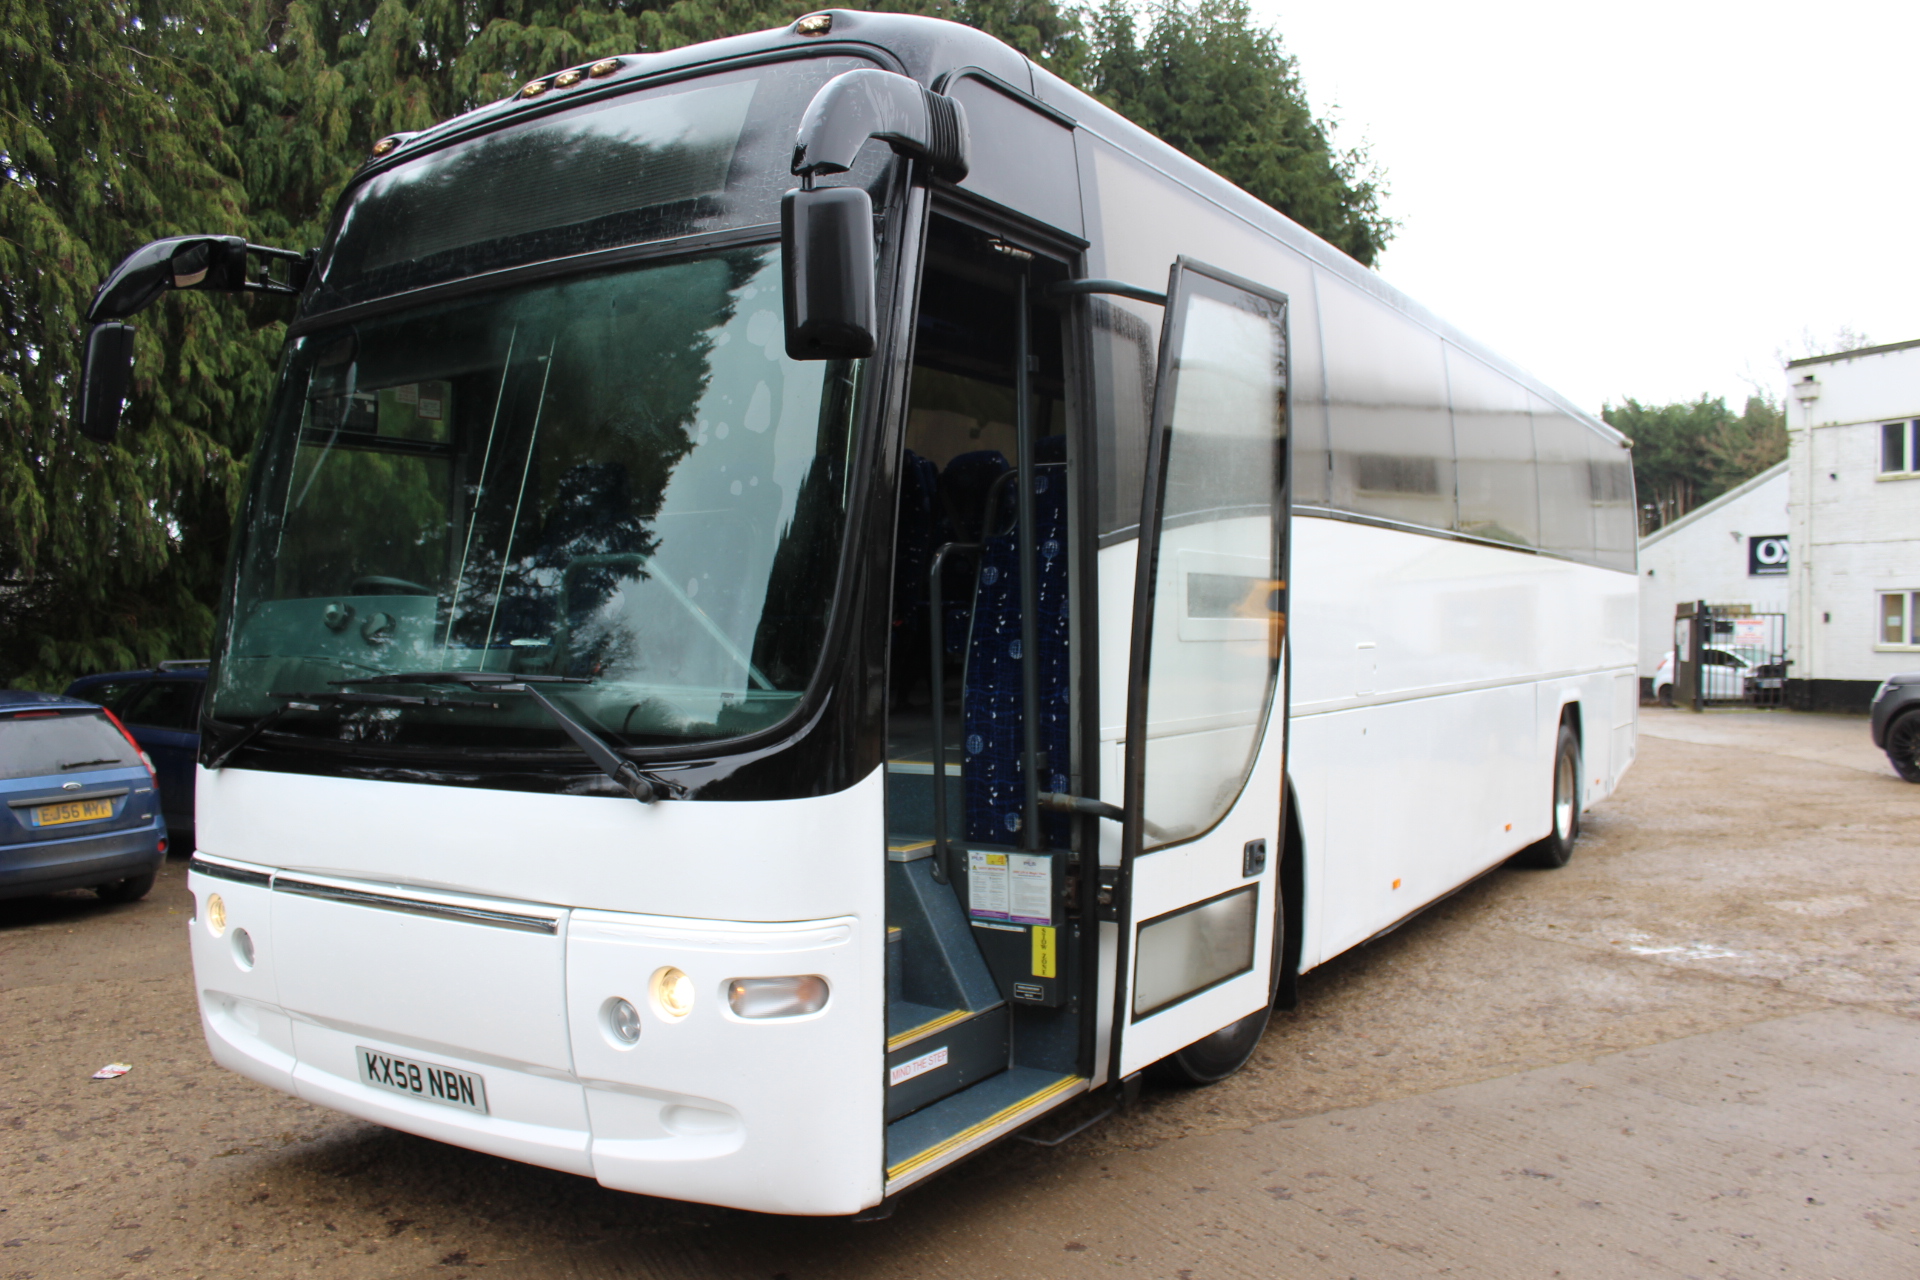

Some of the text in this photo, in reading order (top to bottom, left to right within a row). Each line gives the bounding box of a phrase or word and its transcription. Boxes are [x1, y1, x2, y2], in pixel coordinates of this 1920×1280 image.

[42, 803, 80, 822] EJ56
[366, 1052, 475, 1106] KX58 NBN
[892, 1050, 948, 1080] MIND THE STEP
